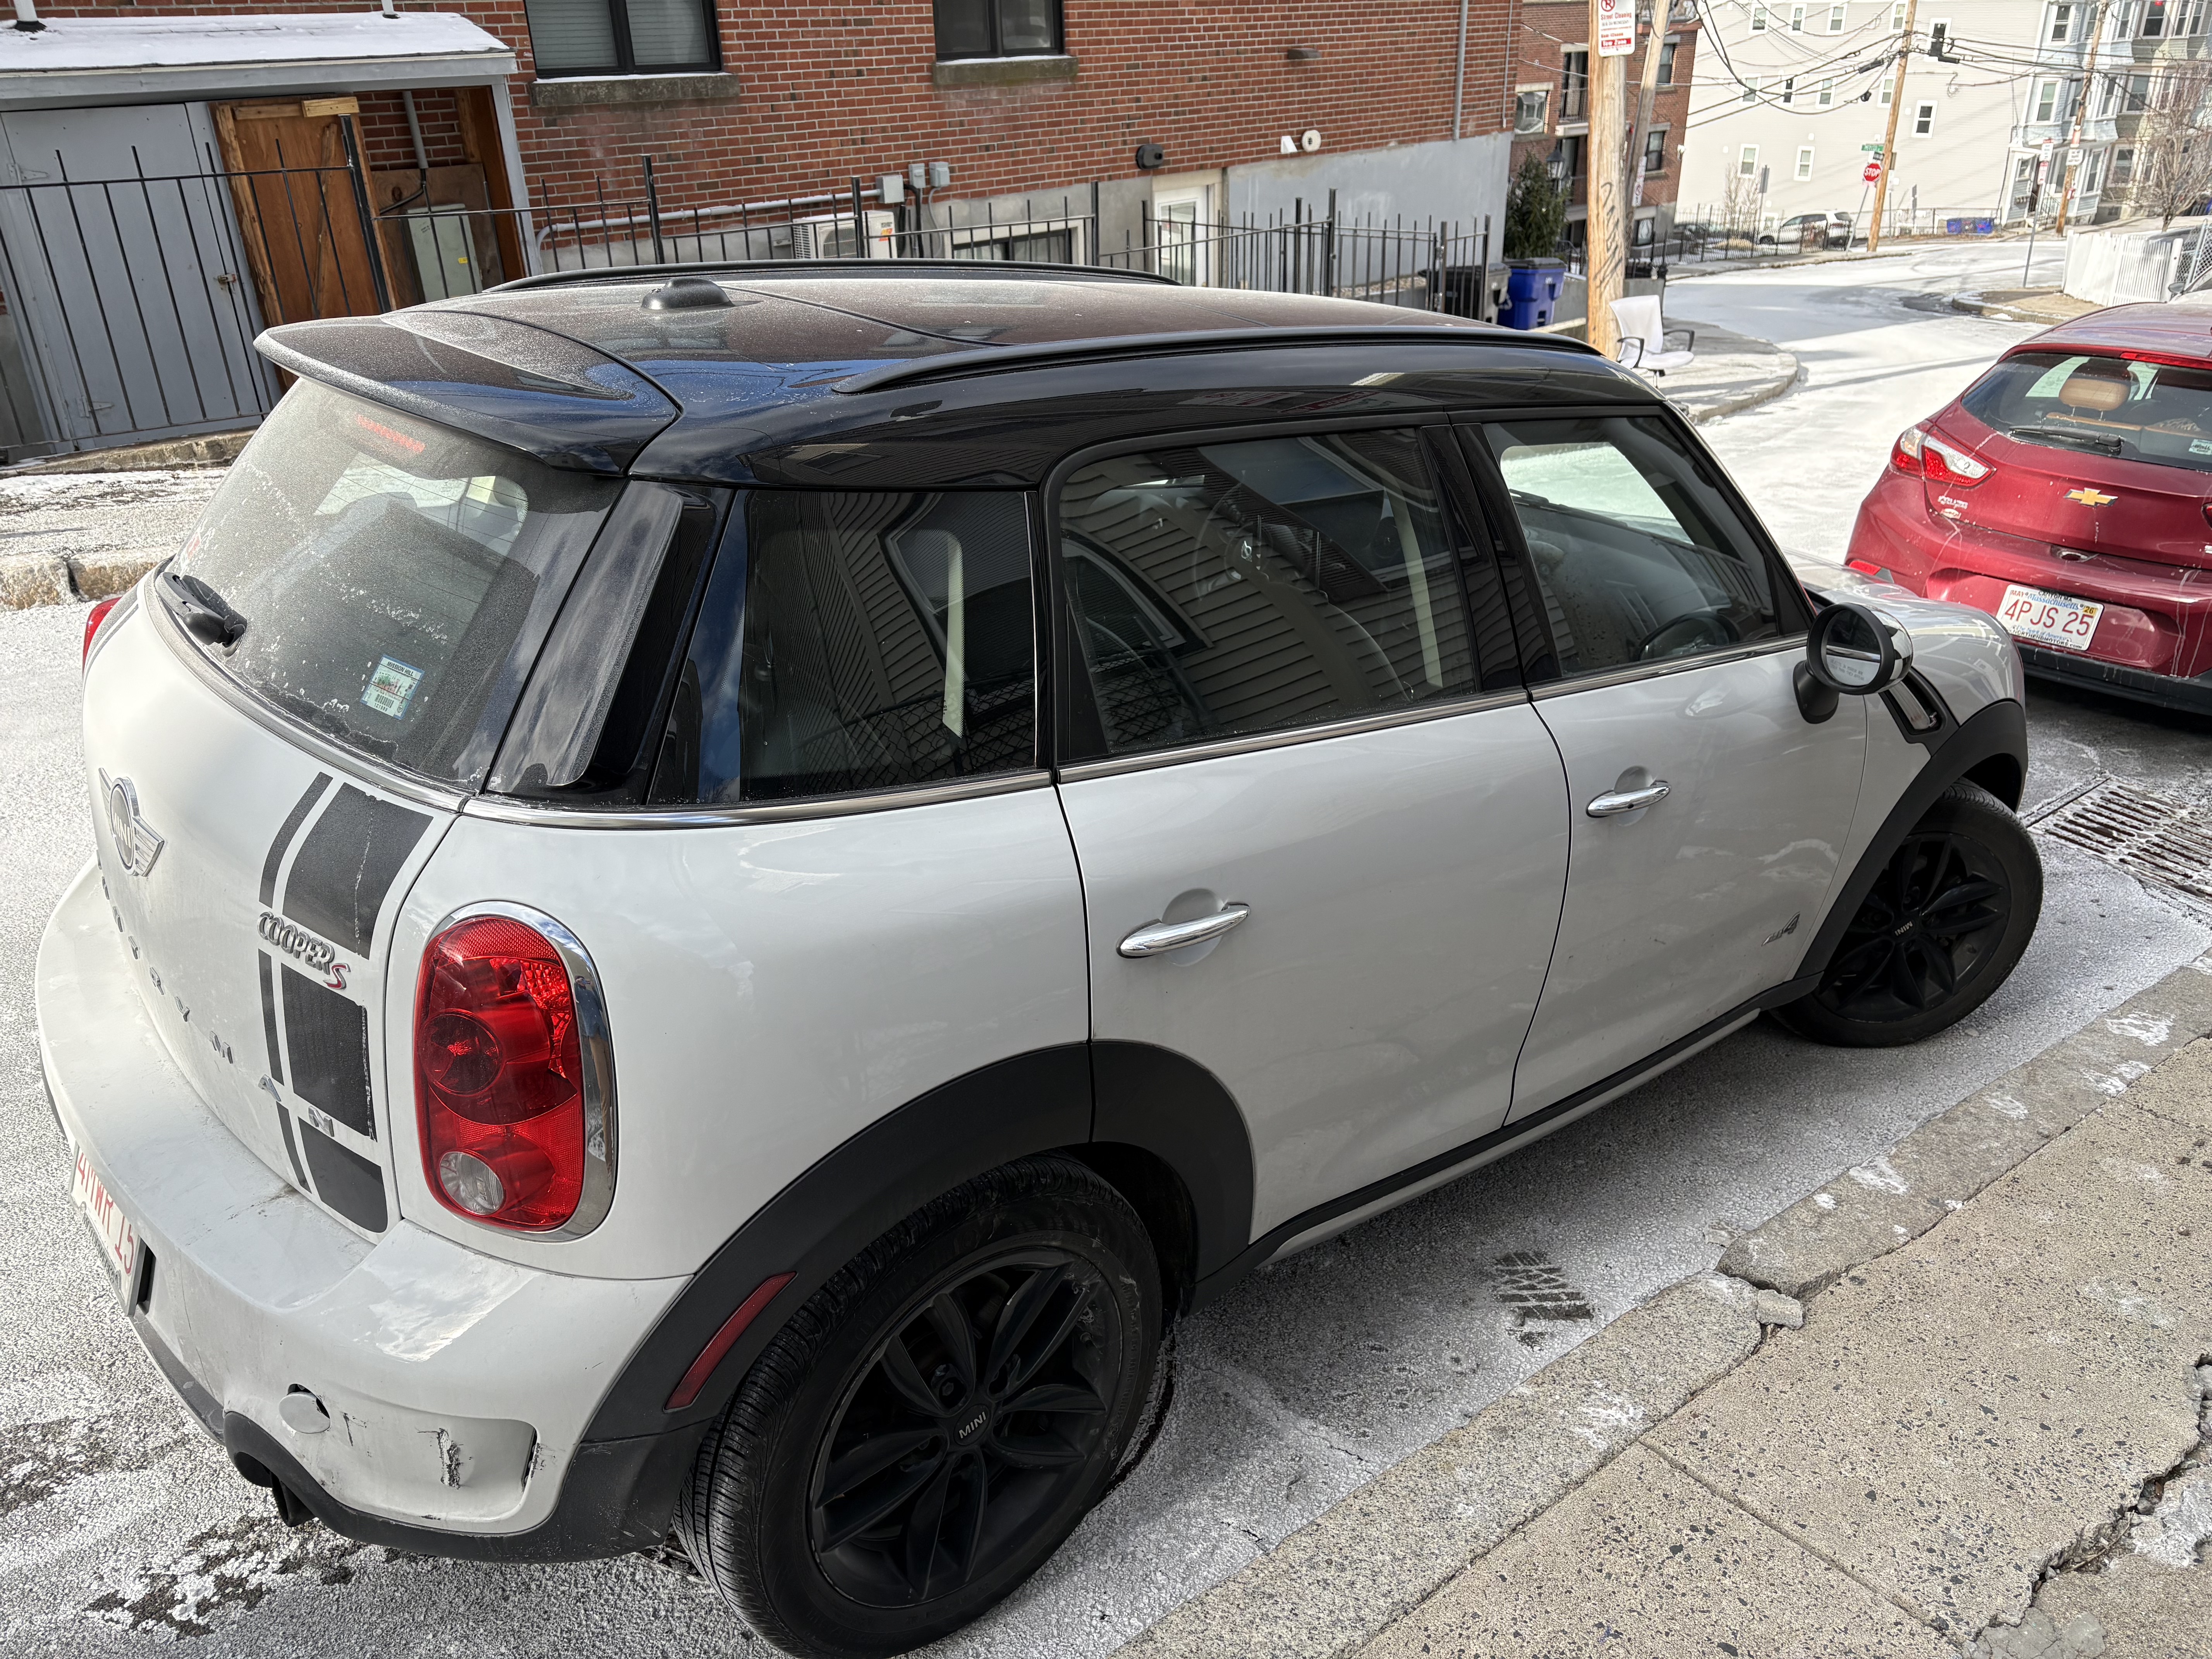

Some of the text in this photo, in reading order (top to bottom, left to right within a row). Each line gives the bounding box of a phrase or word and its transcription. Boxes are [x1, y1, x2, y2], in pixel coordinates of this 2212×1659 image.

[1865, 167, 1881, 177] STOP
[2028, 593, 2079, 611] Massachusetts
[2005, 599, 2094, 636] 4PJS 25
[386, 661, 414, 677] MISSION HILL
[1894, 921, 1913, 936] MINI
[257, 911, 351, 990] COOPER S
[115, 1215, 134, 1274] 15
[958, 1412, 987, 1439] MINI
